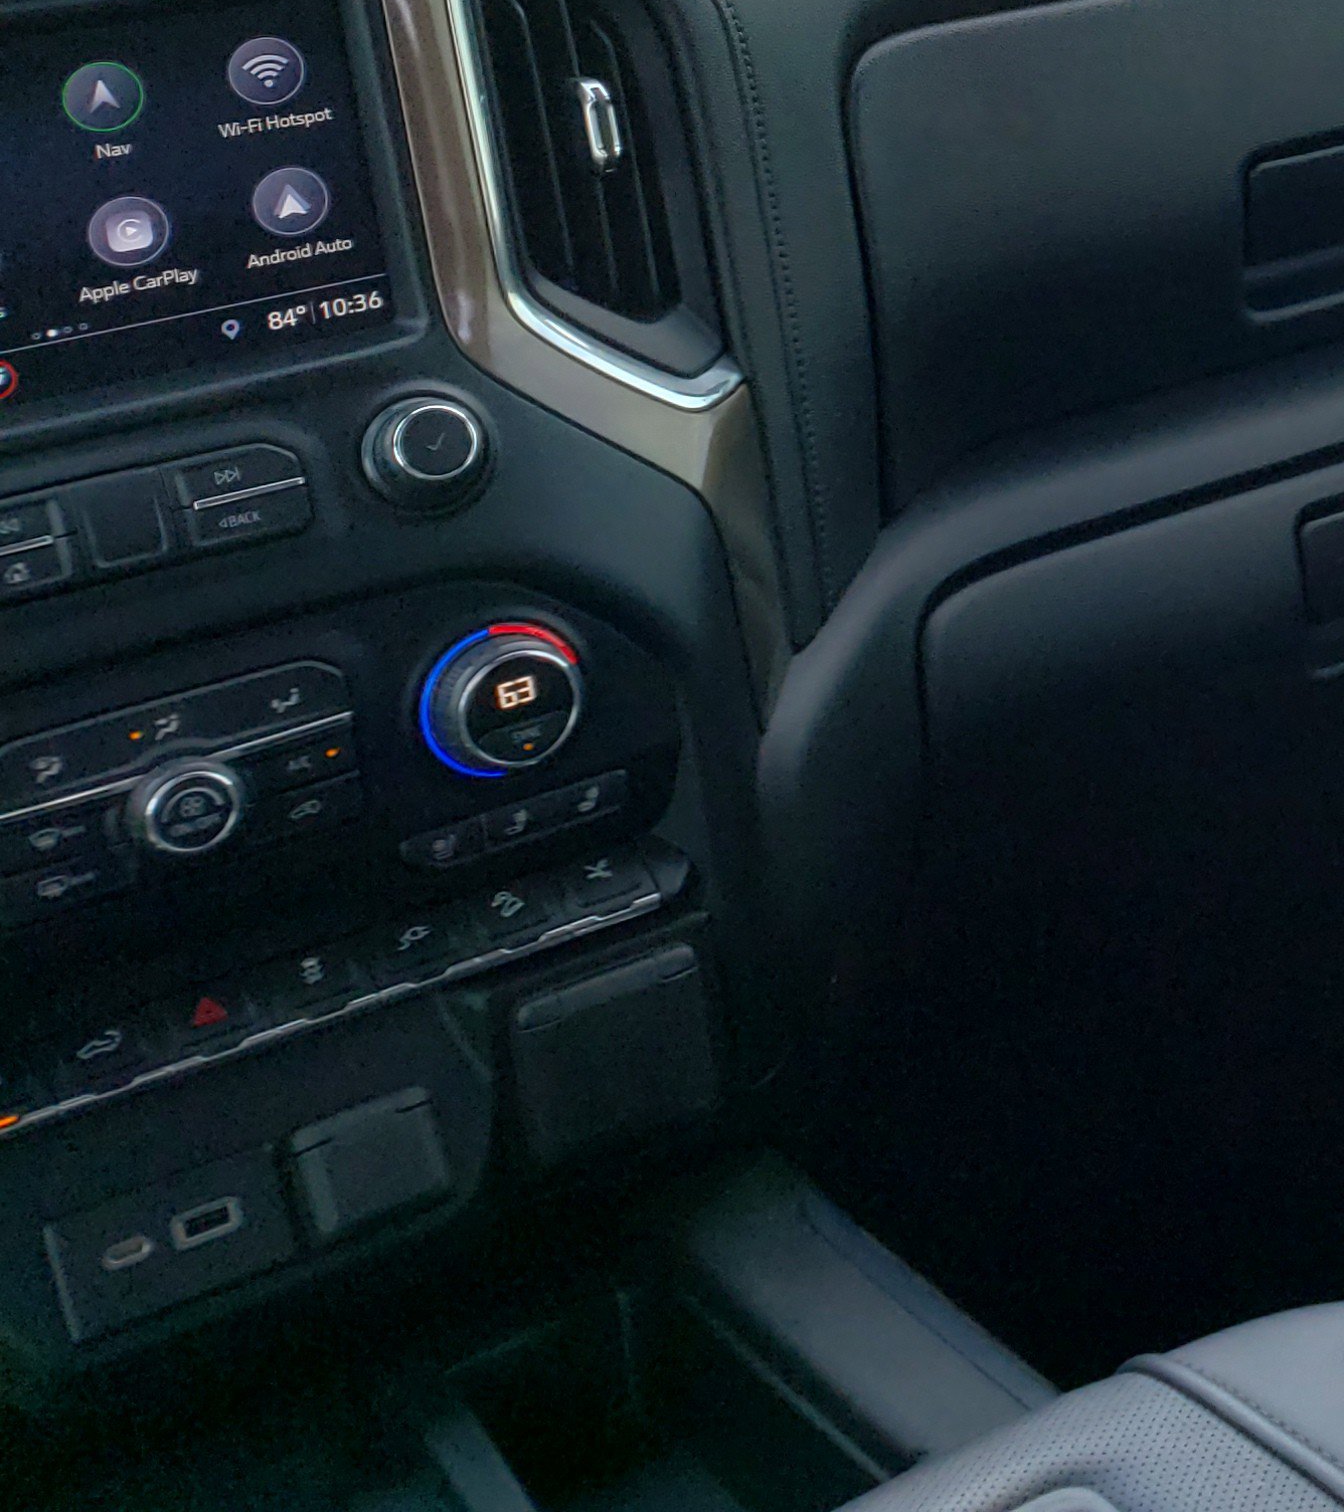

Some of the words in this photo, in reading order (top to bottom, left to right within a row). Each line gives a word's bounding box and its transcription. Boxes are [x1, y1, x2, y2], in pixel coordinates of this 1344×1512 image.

[218, 117, 262, 139] Wi-Fi
[265, 106, 334, 132] Hotspot
[95, 141, 132, 160] Nav
[246, 244, 312, 269] Android
[314, 236, 353, 257] Auto
[78, 278, 130, 304] Apple
[133, 267, 200, 292] CarPlay
[319, 291, 383, 320] 10:36
[229, 510, 262, 528] BACK
[496, 675, 537, 710] 63
